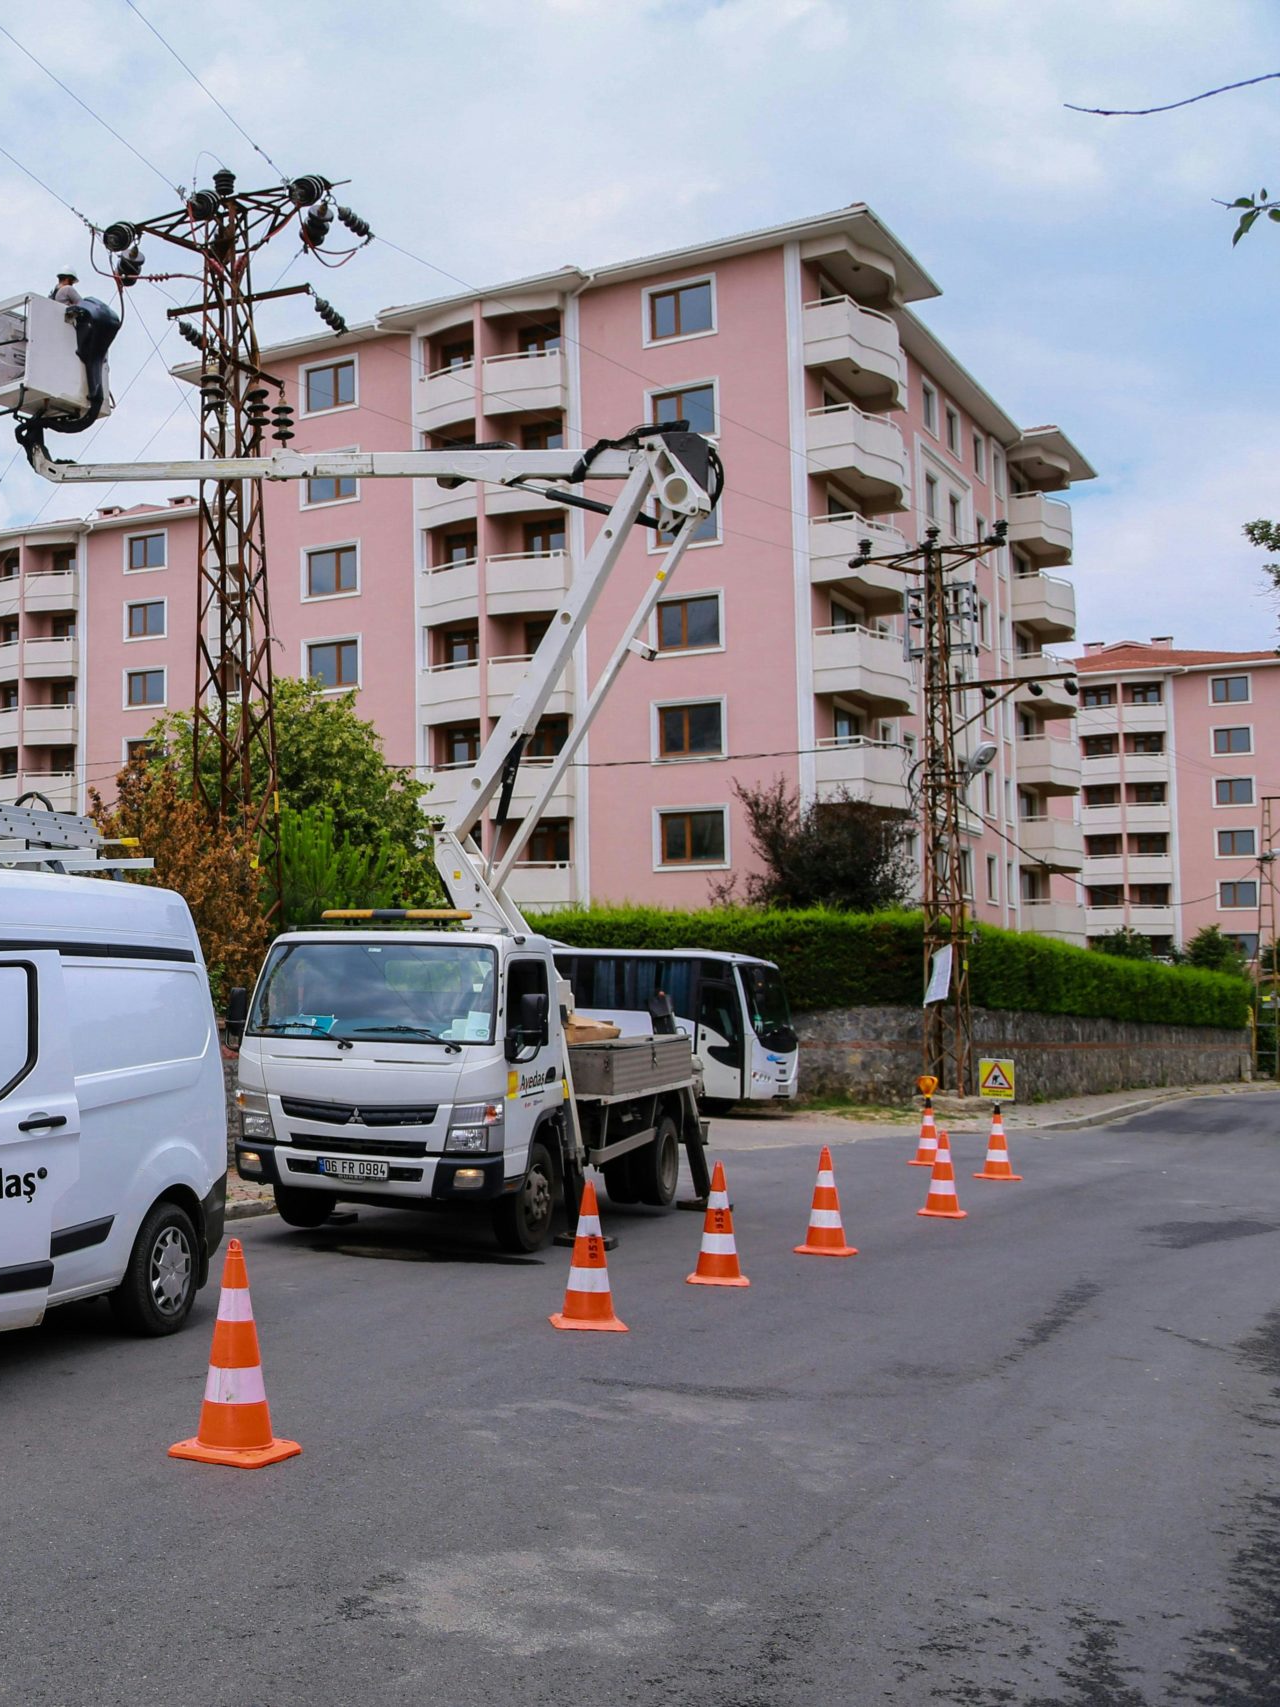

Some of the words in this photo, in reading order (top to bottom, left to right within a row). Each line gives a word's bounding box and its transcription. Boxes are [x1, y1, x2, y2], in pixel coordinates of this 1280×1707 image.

[324, 1160, 338, 1173] 06
[342, 1161, 355, 1174] FR
[359, 1162, 386, 1177] 0984
[588, 1237, 598, 1260] 953
